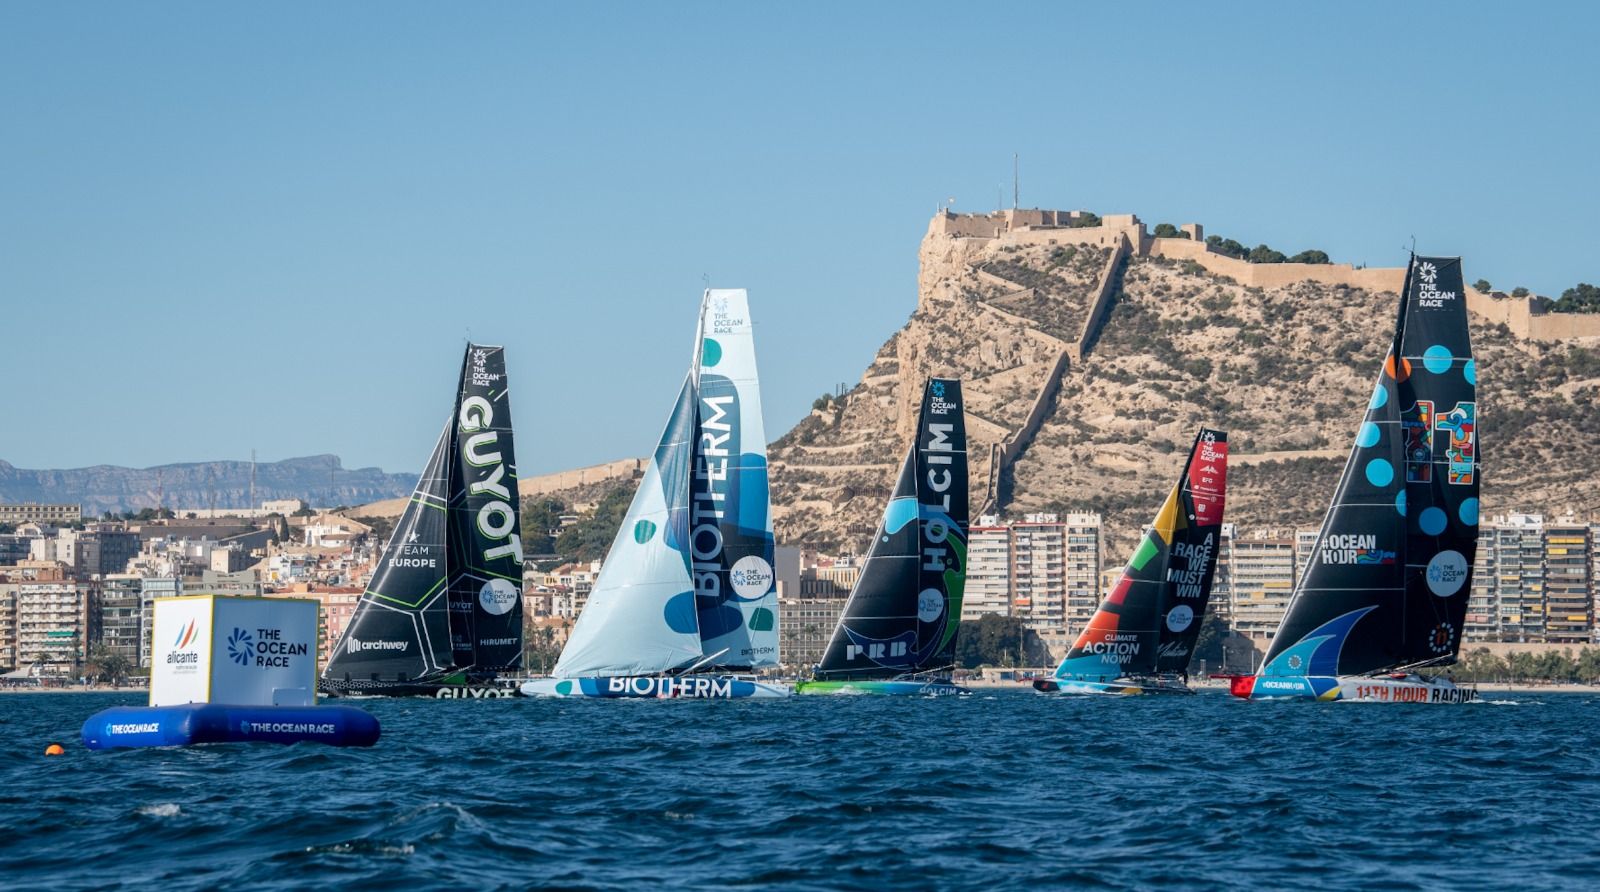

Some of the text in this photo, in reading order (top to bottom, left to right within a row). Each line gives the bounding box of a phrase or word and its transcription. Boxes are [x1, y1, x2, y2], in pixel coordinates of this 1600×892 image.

[1419, 283, 1437, 291] THE
[1419, 290, 1456, 300] OCEAN
[1419, 299, 1444, 307] RACE
[713, 312, 729, 320] THE
[713, 319, 744, 327] OCEAN
[472, 372, 500, 381] OCEAN
[472, 379, 490, 387] RACE
[460, 395, 523, 566] GUYOT
[691, 395, 734, 597] BIOTHERM
[923, 423, 954, 571] HOLCIM
[1203, 532, 1213, 546] A
[1321, 534, 1376, 550] #OCEAN
[398, 546, 429, 555] TEAM
[1174, 541, 1212, 559] RACE
[1322, 549, 1358, 565] HOUR
[388, 559, 436, 568] EUROPE
[1188, 557, 1208, 572] WE
[1166, 568, 1206, 585] MUST
[1176, 584, 1202, 598] WIN
[449, 601, 473, 609] UYOT
[257, 628, 281, 640] THE
[1104, 633, 1138, 642] CLIMATE
[361, 639, 408, 652] archwey
[480, 637, 518, 646] HIRUMET
[1081, 640, 1140, 655] ACTION
[256, 641, 308, 656] OCEAN
[741, 646, 775, 656] BIOTHERM
[846, 641, 907, 661] PRB
[167, 650, 198, 664] alicante
[256, 656, 290, 668] RACE
[1101, 654, 1132, 665] NOW!
[436, 687, 515, 699] GUYOT
[608, 677, 731, 698] BIOTHERM
[1356, 685, 1479, 703] 11TH HOUR RACING
[112, 722, 160, 734] THE OCEAN RACE
[250, 722, 335, 734] THE OCEAN RACE
